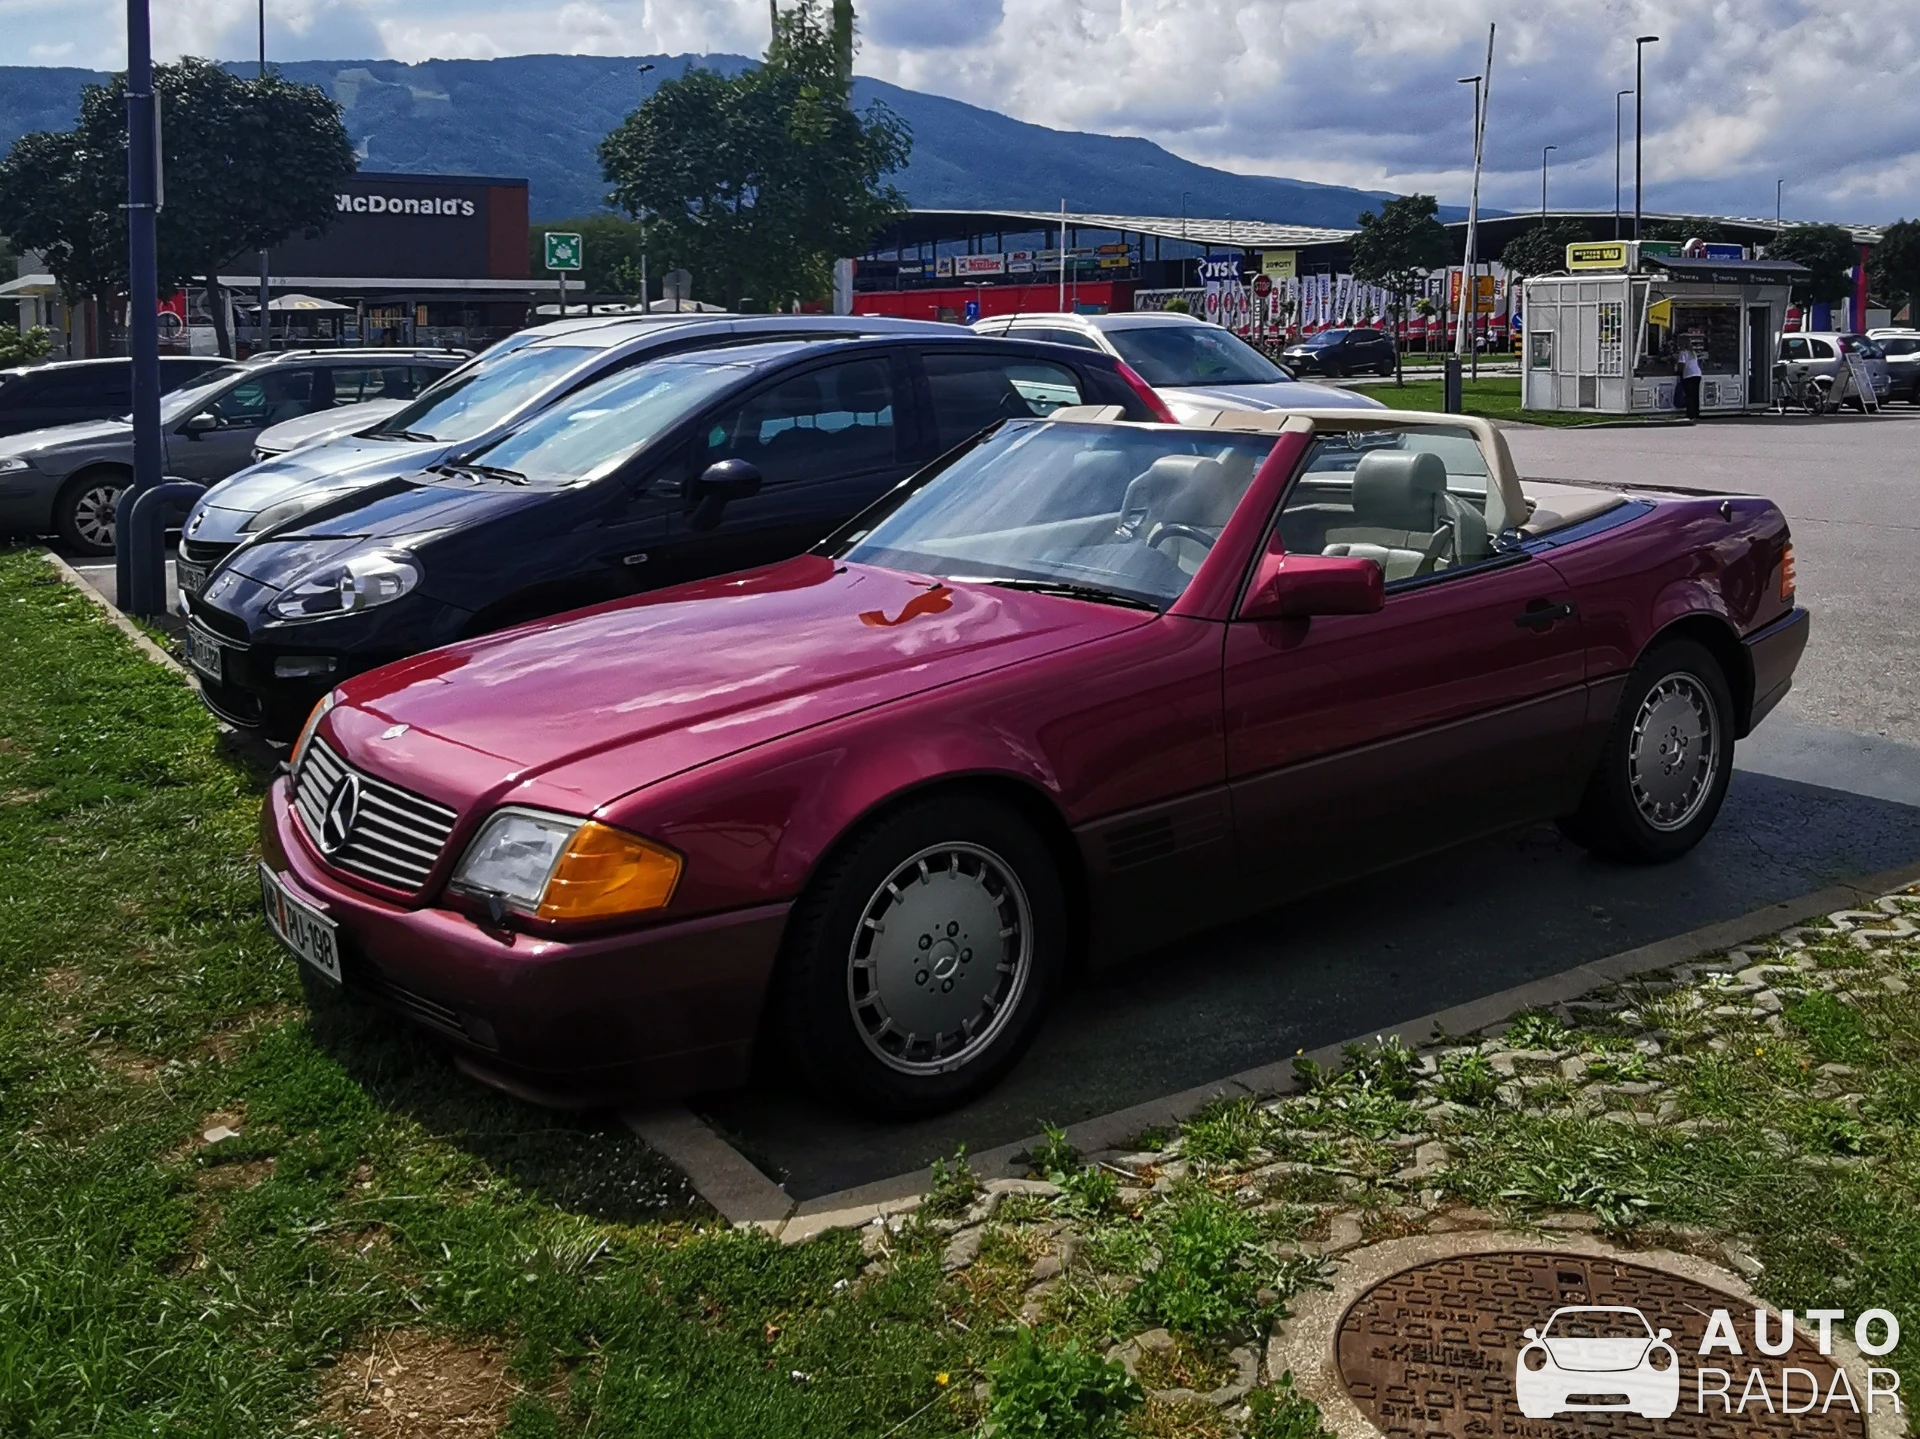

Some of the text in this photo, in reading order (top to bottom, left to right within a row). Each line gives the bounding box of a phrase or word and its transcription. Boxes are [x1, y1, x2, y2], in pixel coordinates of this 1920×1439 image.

[334, 194, 475, 216] McDonald's
[1205, 261, 1239, 277] JYSK
[1255, 281, 1270, 291] STOP
